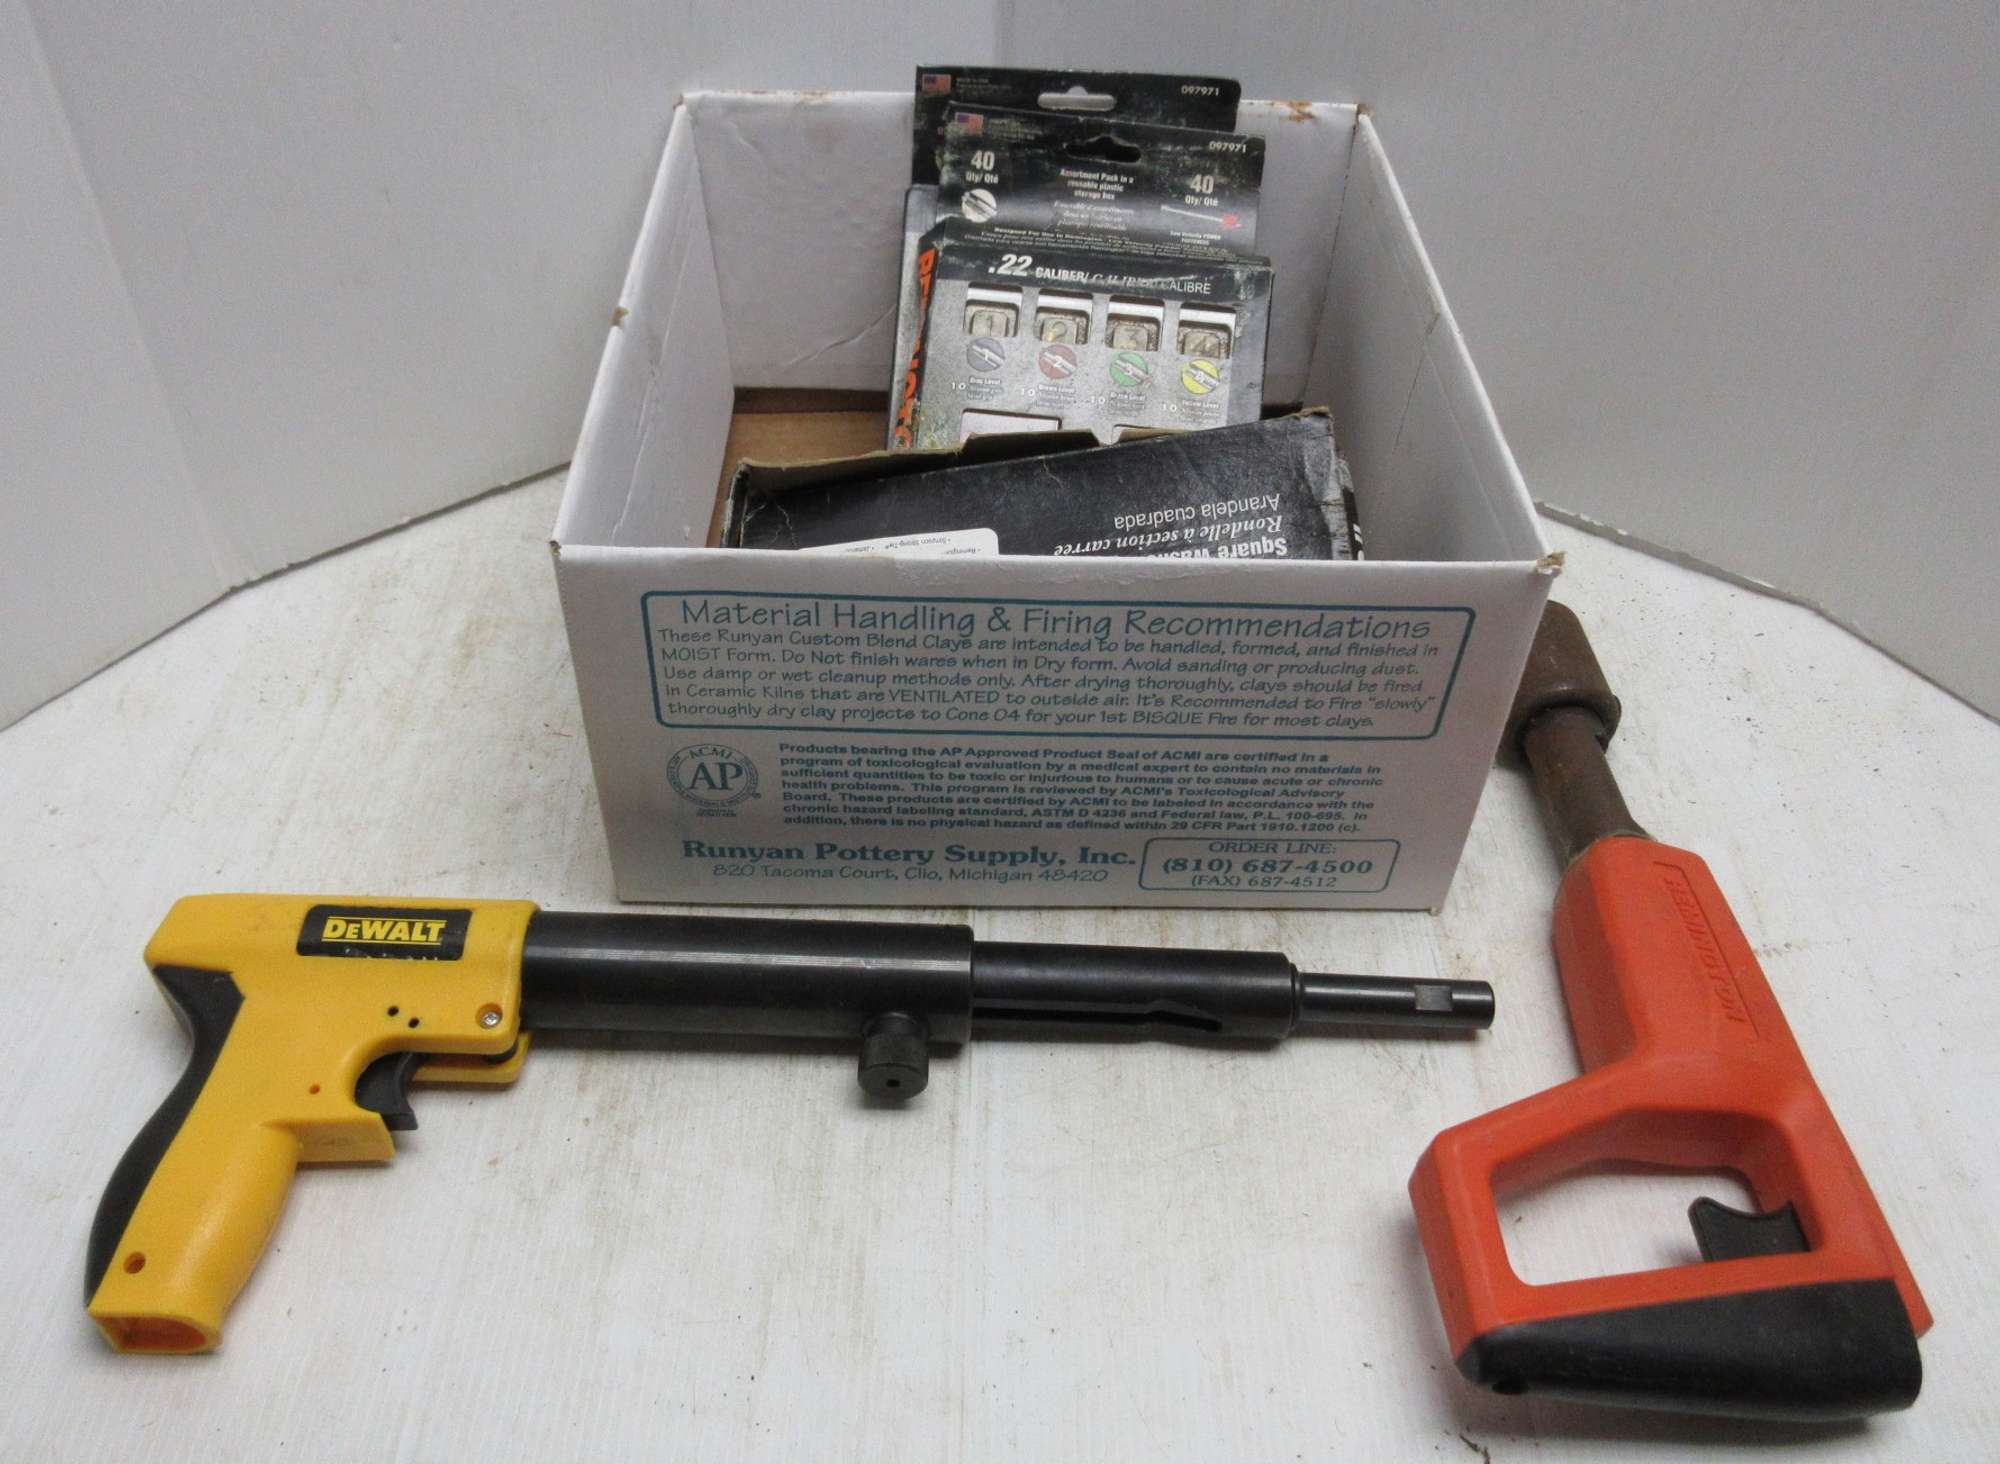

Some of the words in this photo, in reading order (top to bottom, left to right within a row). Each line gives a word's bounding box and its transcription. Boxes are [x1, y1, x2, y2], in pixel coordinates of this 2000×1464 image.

[1181, 85, 1219, 96] 097971
[1209, 141, 1246, 153] 097971
[971, 150, 995, 171] 40
[1190, 174, 1214, 194] 40
[988, 254, 1033, 277] .22
[1202, 493, 1280, 520] Arandela
[1114, 506, 1196, 531] cuadrada
[1199, 515, 1283, 542] Rondelle
[1117, 530, 1178, 551] section
[1217, 537, 1288, 559] Square
[682, 600, 821, 627] Material
[834, 603, 975, 635] Handling
[986, 606, 1010, 631] &
[1023, 607, 1112, 637] Firing
[1124, 609, 1430, 638] Recommendations
[658, 629, 712, 642] These
[717, 631, 783, 647] Runyan
[788, 632, 860, 646] Custom
[866, 634, 917, 648] Blend
[922, 635, 972, 652] Clays
[978, 639, 1006, 650] are
[1012, 637, 1092, 651] intended
[1096, 639, 1118, 652] to
[1124, 639, 1144, 652] be
[1150, 640, 1225, 657] handled,
[1232, 641, 1301, 658] formed,
[1306, 642, 1342, 655] and
[1347, 642, 1418, 656] finished
[1422, 643, 1438, 656] in
[660, 648, 721, 661] MOIST
[726, 650, 777, 663] Form.
[781, 651, 805, 663] Do
[810, 651, 844, 664] Not
[850, 652, 899, 665] finish
[904, 656, 957, 667] wares
[962, 655, 1006, 668] when
[1012, 655, 1028, 668] in
[1034, 656, 1066, 672] Dry
[1070, 656, 1117, 670] form.
[1122, 657, 1172, 671] Avoid
[1176, 658, 1248, 675] sanding
[1252, 662, 1273, 672] or
[1276, 659, 1366, 677] producing
[1372, 661, 1420, 674] dust.
[663, 666, 696, 679] Use
[702, 667, 752, 684] damp
[758, 671, 776, 681] or
[781, 669, 812, 682] wet
[818, 670, 886, 687] cleanup
[892, 671, 972, 685] methods
[976, 673, 1016, 689] only.
[1020, 674, 1070, 687] After
[1074, 675, 1130, 691] drying
[1137, 676, 1234, 693] thoroughly,
[1239, 677, 1287, 694] clays
[1292, 678, 1352, 691] should
[1357, 678, 1377, 692] be
[1384, 679, 1423, 692] fired
[686, 684, 756, 698] Ceramic
[762, 686, 804, 699] Kilns
[810, 688, 851, 701] that
[856, 691, 885, 701] are
[888, 689, 1000, 704] VENTILATED
[1006, 691, 1026, 704] to
[1030, 692, 1098, 705] outside
[1170, 694, 1299, 708] Recommended
[1304, 695, 1324, 708] to
[1328, 695, 1362, 709] Fire
[668, 701, 762, 718] thoroughly
[766, 703, 796, 719] dry
[800, 704, 836, 720] clay
[841, 704, 915, 721] projects
[920, 706, 941, 720] to
[945, 706, 989, 720] Cone
[1026, 708, 1050, 721] for
[1055, 711, 1096, 725] your
[1132, 710, 1202, 724] BISQUE
[1208, 711, 1238, 724] Fire
[1243, 711, 1268, 725] for
[1273, 712, 1320, 726] most
[688, 746, 733, 759] ACMI
[778, 743, 848, 754] Products
[850, 744, 908, 756] bearing
[912, 745, 936, 755] the
[940, 746, 962, 756] AP
[964, 746, 1039, 758] Approved
[1042, 747, 1102, 758] Product
[1106, 748, 1140, 759] Seal
[1141, 749, 1158, 759] of
[1160, 749, 1201, 760] ACMI
[1204, 752, 1230, 760] are
[1233, 751, 1298, 761] certified
[1300, 752, 1315, 761] in
[1318, 753, 1328, 762] a
[688, 762, 743, 790] AP
[781, 781, 827, 791] health
[830, 781, 905, 793] problems.
[913, 782, 942, 792] This
[946, 784, 1009, 794] program
[1012, 783, 1025, 793] is
[1029, 784, 1096, 794] reviewed
[1099, 785, 1116, 796] by
[1178, 786, 1276, 798] Toxicological
[1279, 787, 1344, 800] Advisory
[682, 840, 804, 863] Runyan
[815, 842, 934, 865] Pottery
[944, 843, 1067, 866] Supply,
[1078, 845, 1137, 865] Inc.
[1208, 841, 1279, 854] ORDER
[712, 863, 755, 877] 820
[761, 864, 834, 878] Tacoma
[838, 865, 899, 881] Court,
[904, 866, 942, 882] Clio,
[948, 867, 1032, 883] Michigan
[1038, 868, 1109, 882] 48420
[1162, 857, 1233, 875] (810)
[1242, 859, 1374, 874] 687-4500
[1191, 875, 1240, 888] (FAX)
[1248, 876, 1338, 888] 687-4512
